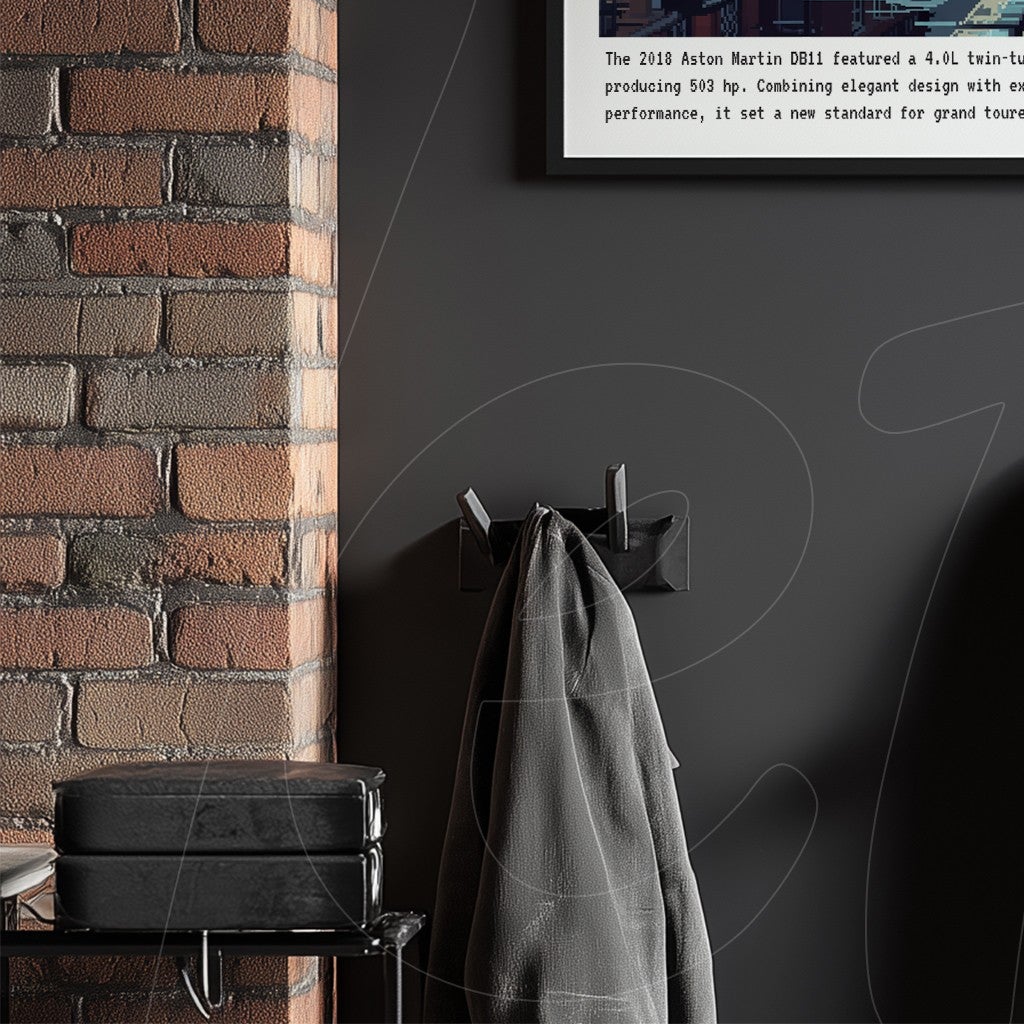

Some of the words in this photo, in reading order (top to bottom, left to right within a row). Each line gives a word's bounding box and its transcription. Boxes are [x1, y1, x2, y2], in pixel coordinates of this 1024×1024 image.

[605, 51, 631, 66] The
[639, 51, 672, 66] 2018
[681, 51, 724, 66] Aston
[731, 51, 782, 66] Martin
[790, 50, 824, 66] DB11
[833, 50, 900, 66] featured
[907, 54, 917, 66] a
[924, 50, 959, 66] 4.0L
[605, 78, 681, 97] producing
[690, 78, 715, 93] 503
[723, 78, 746, 97] hp.
[756, 78, 833, 97] Combining
[841, 78, 899, 97] elegant
[908, 78, 959, 96] design
[967, 78, 1001, 92] with
[605, 106, 704, 124] performance,
[715, 106, 731, 120] it
[740, 106, 765, 120] set
[773, 109, 782, 120] a
[790, 109, 816, 120] new
[824, 105, 892, 120] standard
[900, 105, 925, 120] for
[933, 105, 976, 124] grand
